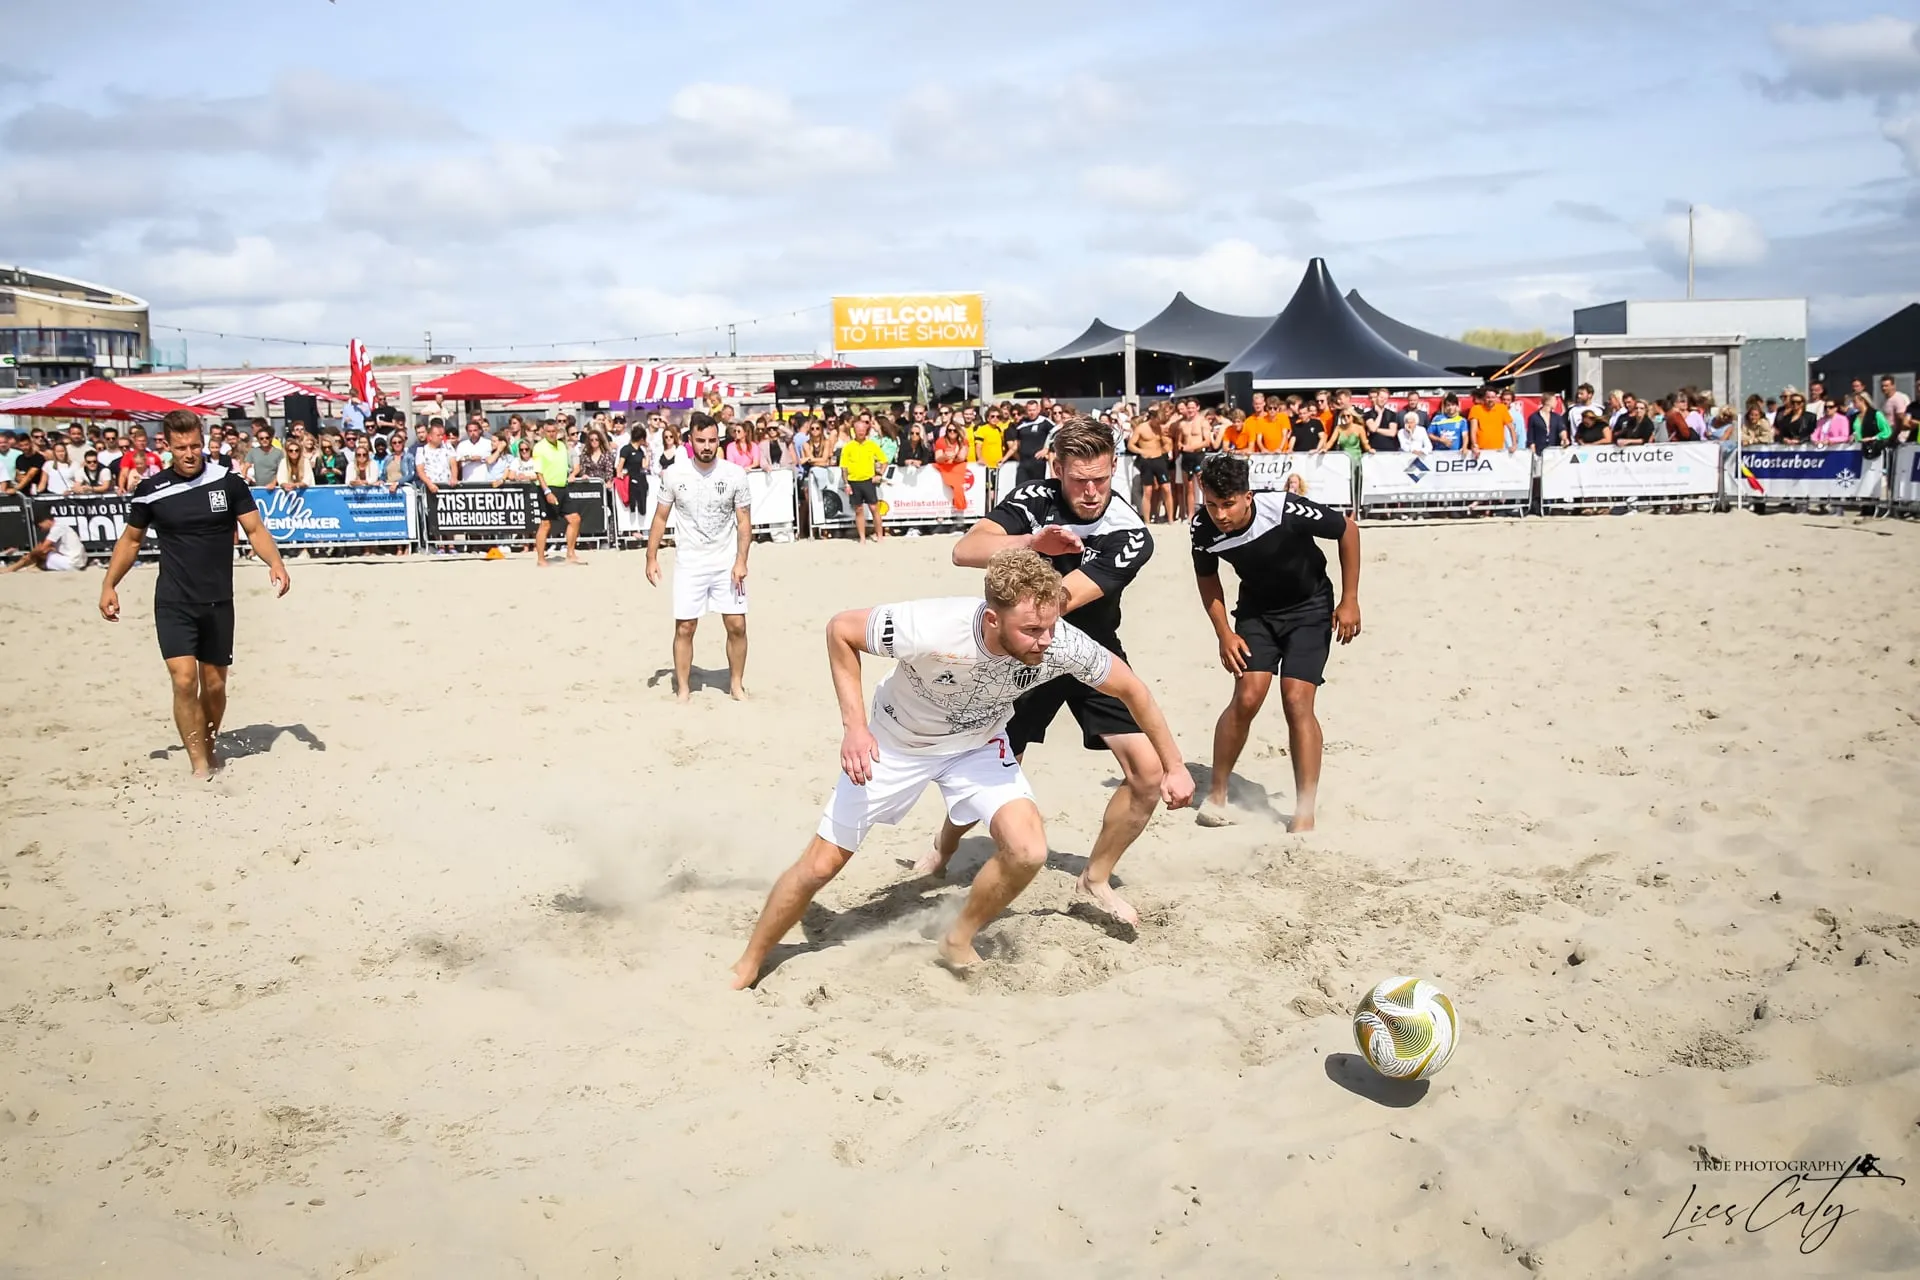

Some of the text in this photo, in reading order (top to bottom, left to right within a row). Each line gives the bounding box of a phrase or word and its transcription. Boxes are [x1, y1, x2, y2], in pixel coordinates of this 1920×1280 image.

[848, 306, 967, 325] WELCOME
[840, 324, 978, 342] TO THE SHOW
[1596, 449, 1673, 463] activate
[1743, 454, 1825, 469] Kloosterboer
[1436, 460, 1493, 473] DEPA
[50, 503, 132, 515] AUTOMOBIE
[436, 493, 524, 511] AMSTERDAM
[264, 517, 340, 530] VENTMAKER
[437, 511, 506, 526] WAREHOUSE
[988, 738, 1005, 759] 7
